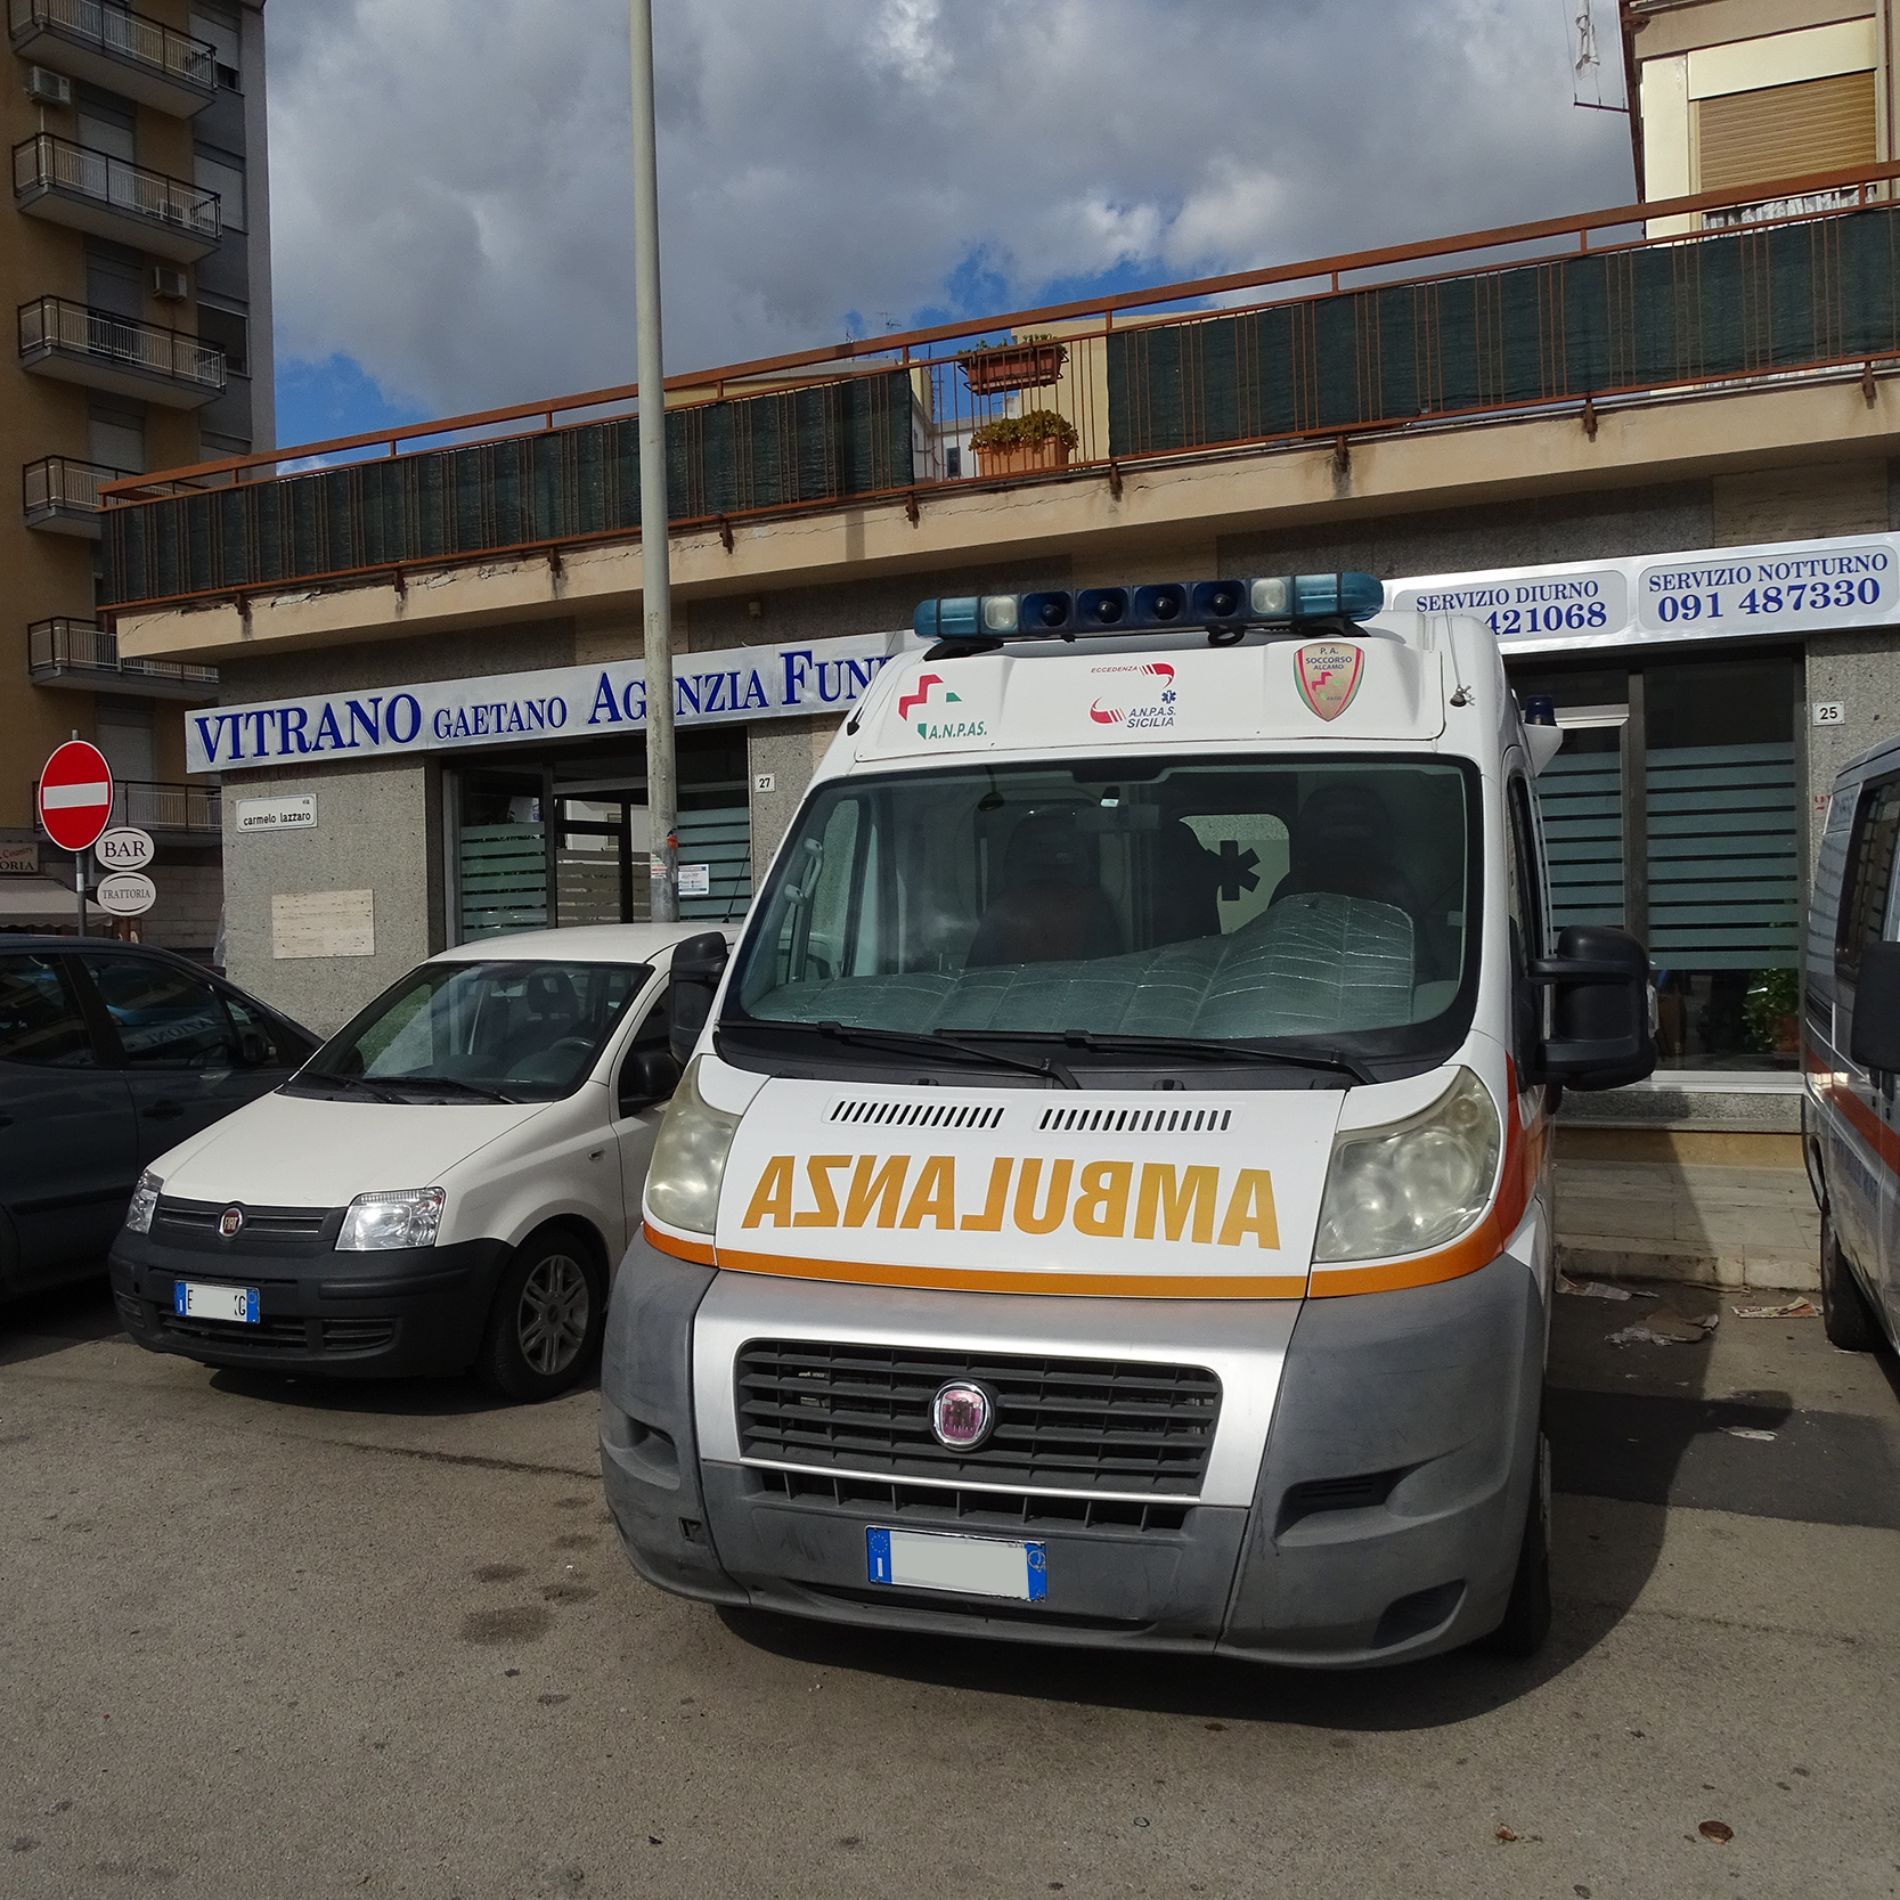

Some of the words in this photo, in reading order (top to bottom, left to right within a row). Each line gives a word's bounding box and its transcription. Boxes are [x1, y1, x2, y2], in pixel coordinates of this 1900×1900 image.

[1648, 566, 1752, 593] SERVIZIO
[1758, 553, 1888, 582] NOTTURNO
[1416, 586, 1510, 613] SERVIZIO
[1515, 580, 1599, 604] DIURNO
[1658, 592, 1724, 622] 091
[1738, 577, 1880, 615] 487330
[1485, 601, 1607, 636] 421068
[1305, 655, 1353, 665] SOCCORSO
[1090, 665, 1138, 674] ECCEDENZA
[194, 693, 422, 764] VITRANO
[433, 694, 568, 740] GAETANO
[587, 668, 769, 725] AGNZIA
[780, 649, 894, 706] FUN
[1819, 706, 1838, 720] 25
[1126, 717, 1175, 728] SICILIA
[758, 777, 771, 789] 27
[243, 814, 277, 826] carmelo
[279, 812, 311, 823] lazzaro
[104, 840, 147, 858] BAR
[103, 888, 151, 900] TRATTORIA
